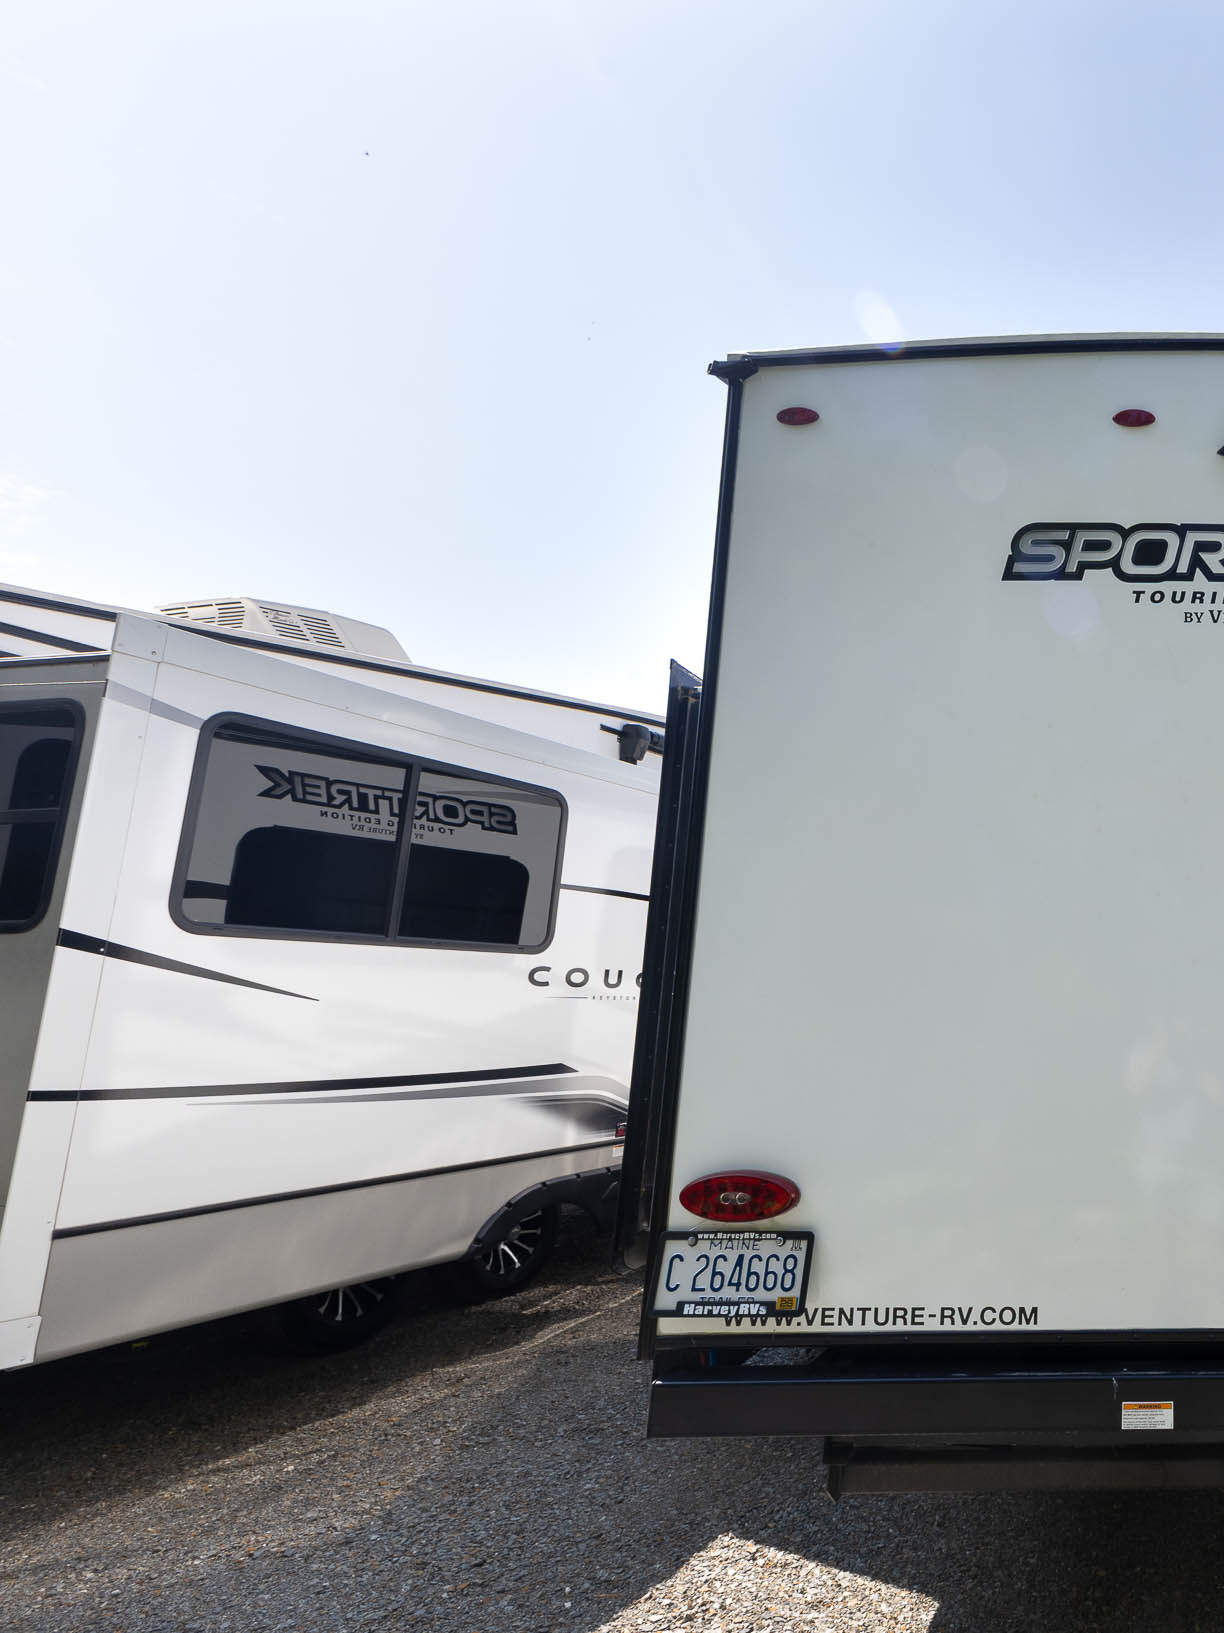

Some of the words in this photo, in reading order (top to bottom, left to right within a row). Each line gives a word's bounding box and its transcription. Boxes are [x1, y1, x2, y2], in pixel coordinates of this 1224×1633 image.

[1183, 611, 1204, 623] BY
[709, 1240, 760, 1251] MAINE
[665, 1253, 685, 1292] C
[691, 1253, 798, 1292] 264668
